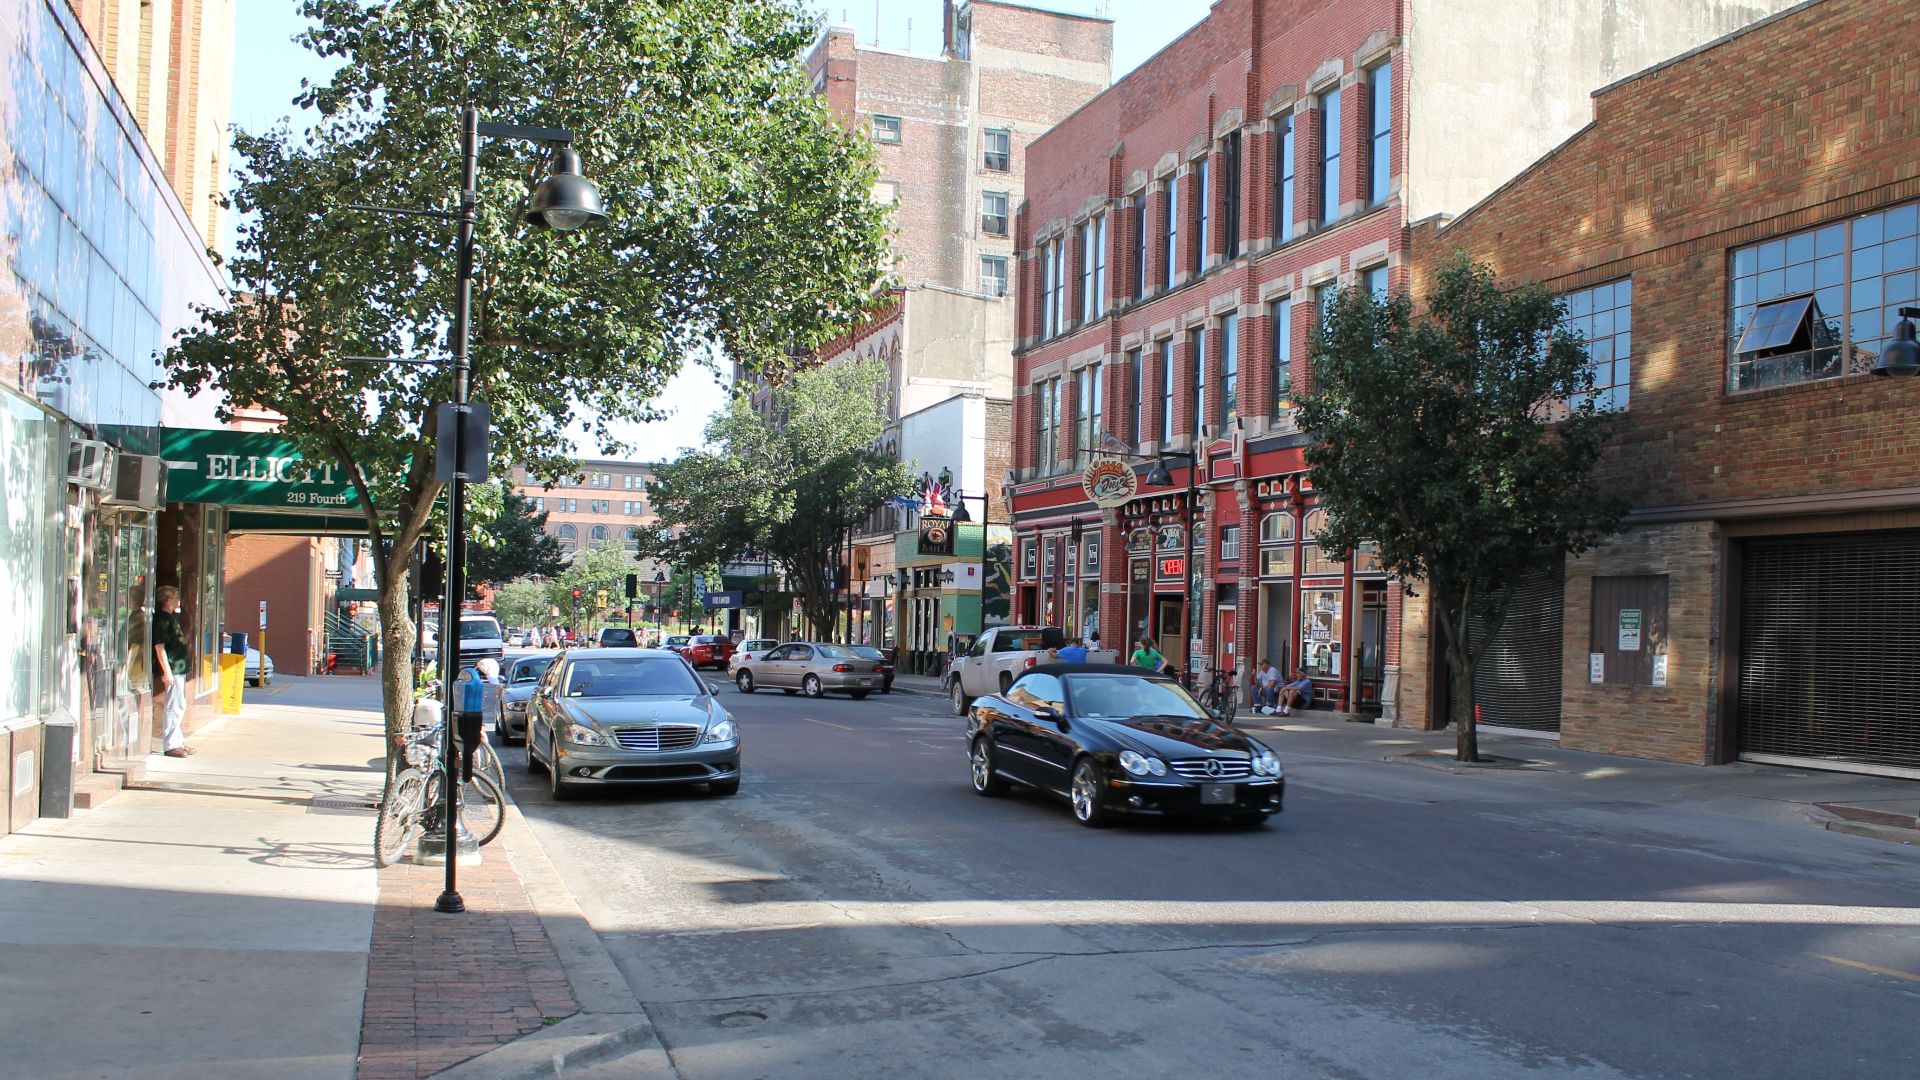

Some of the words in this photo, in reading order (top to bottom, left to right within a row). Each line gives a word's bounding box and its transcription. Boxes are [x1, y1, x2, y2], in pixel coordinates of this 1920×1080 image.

[287, 492, 305, 504] 219
[310, 494, 347, 505] Fourth
[1164, 559, 1183, 575] OPEN
